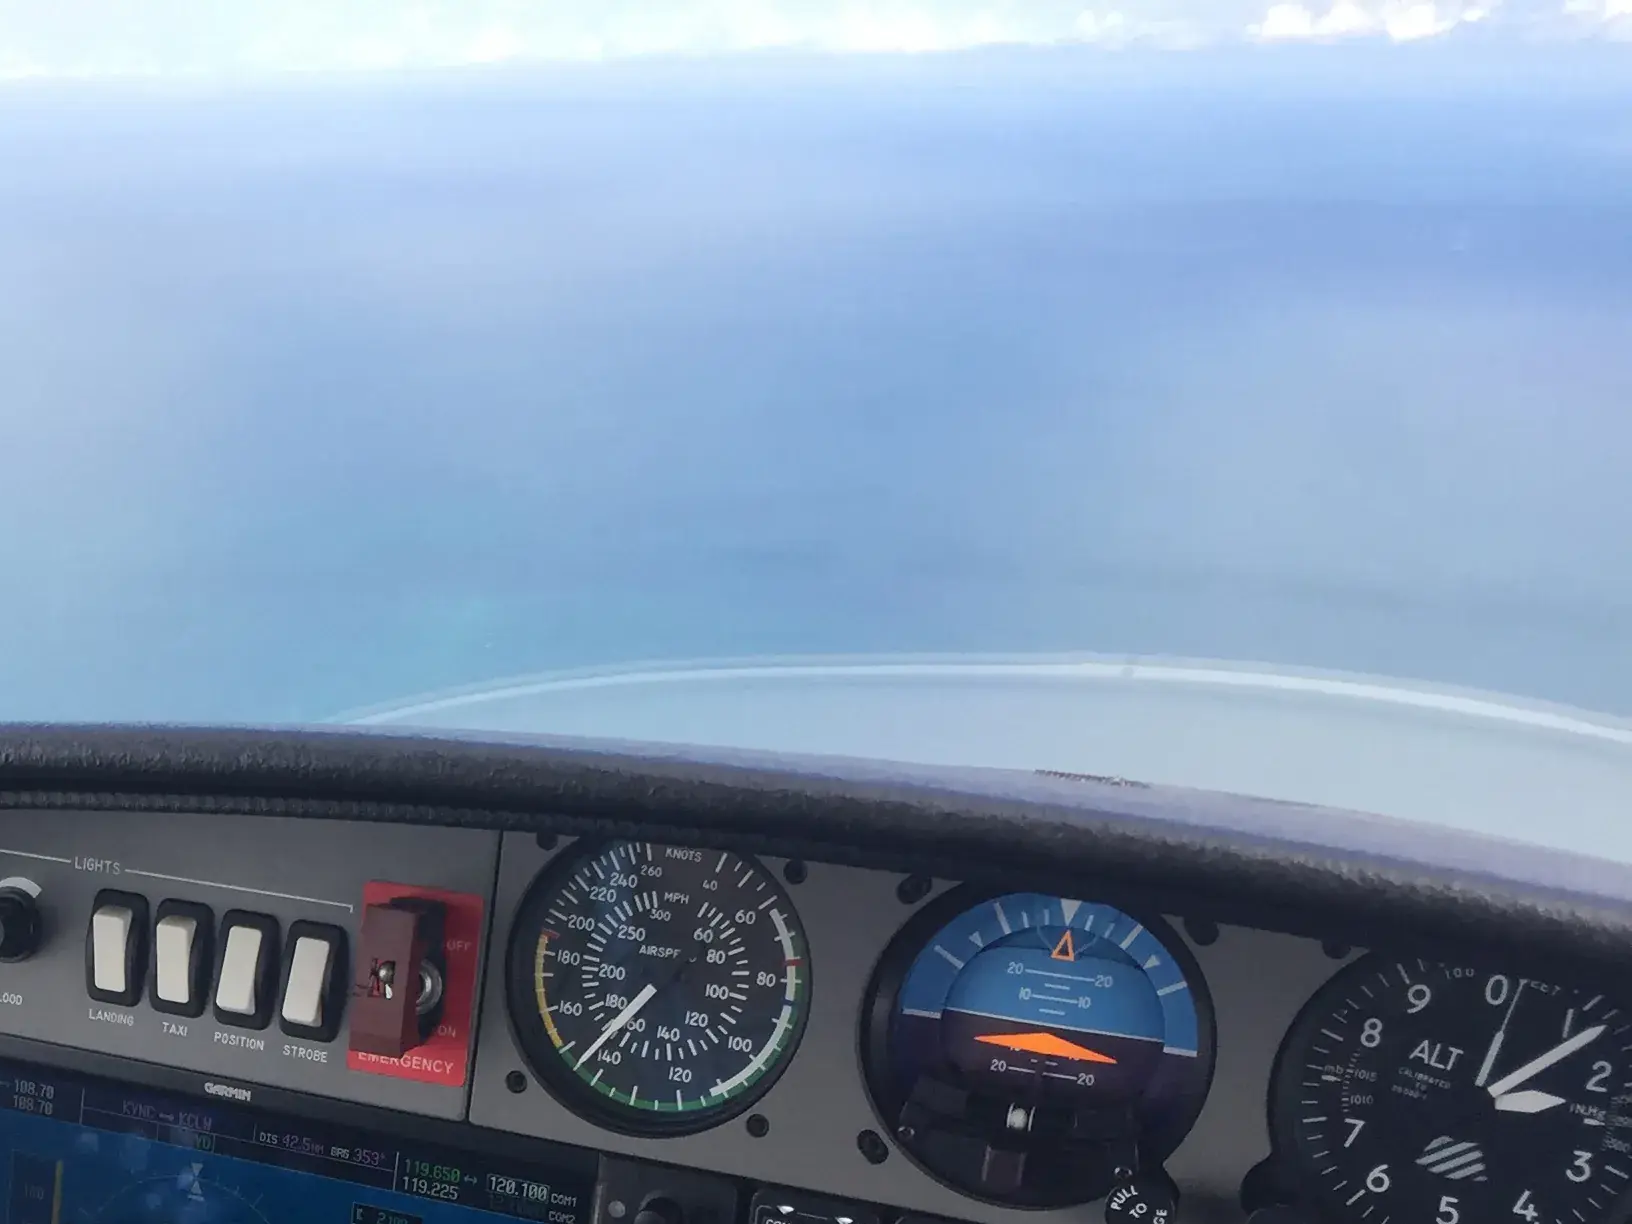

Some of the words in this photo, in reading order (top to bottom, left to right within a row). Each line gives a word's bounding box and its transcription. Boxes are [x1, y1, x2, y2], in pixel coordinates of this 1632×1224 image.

[665, 848, 702, 863] KNOTS
[74, 856, 121, 875] LIGHTS
[640, 864, 663, 878] 260
[609, 873, 638, 888] 240
[589, 887, 617, 902] 220
[664, 892, 690, 904] MPH
[568, 915, 595, 932] 200
[617, 927, 646, 941] 250
[556, 950, 580, 965] 180
[598, 964, 626, 980] 200
[1007, 961, 1024, 975] 20
[1407, 984, 1431, 1014] 9
[88, 1008, 134, 1026] LANDING
[162, 1021, 189, 1037] TAXI
[1360, 1018, 1383, 1048] 8
[214, 1032, 264, 1051] POSITION
[283, 1045, 328, 1063] STROBE
[358, 1051, 454, 1074] EMERGENCY
[1408, 1039, 1464, 1071] ALT
[990, 1059, 1007, 1073] 20
[1585, 1061, 1612, 1092] 2
[13, 1079, 55, 1100] 108.70
[203, 1081, 252, 1102] GARMIN
[402, 1176, 459, 1200] 119.225
[489, 1176, 548, 1200] 120.100
[1110, 1185, 1138, 1211] PULL
[1129, 1202, 1147, 1220] TO
